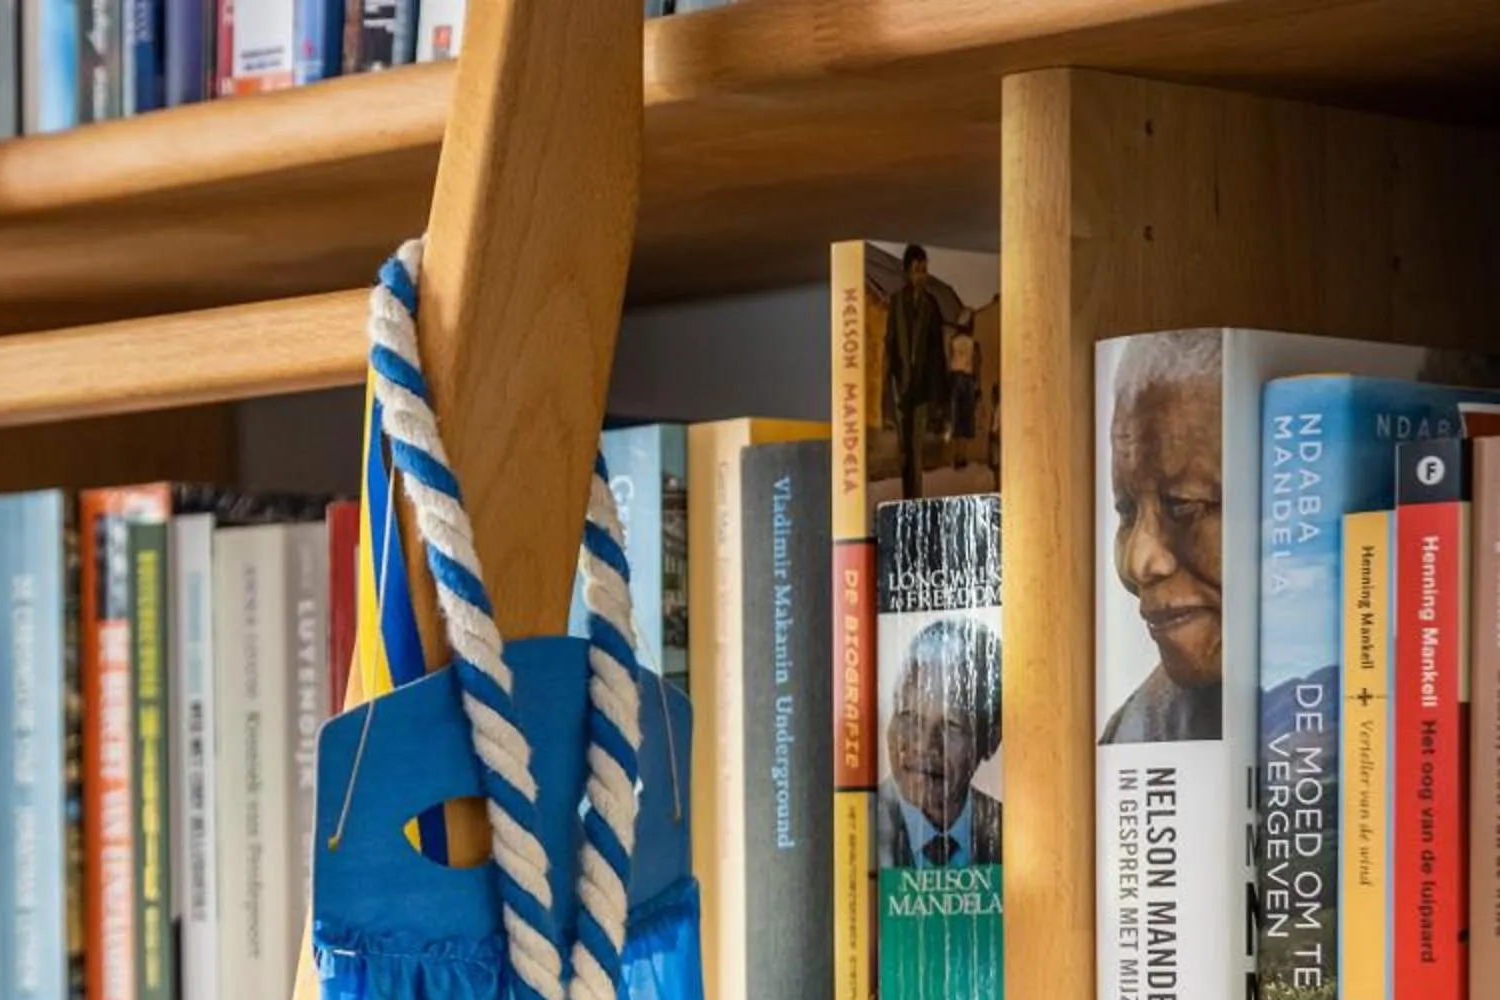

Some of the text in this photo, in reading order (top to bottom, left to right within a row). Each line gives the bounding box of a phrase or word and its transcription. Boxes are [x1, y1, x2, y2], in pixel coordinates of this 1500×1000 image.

[842, 287, 858, 494] NELSON MANDELA
[1272, 415, 1293, 595] MANDELA
[1298, 413, 1322, 543] NDABA
[1357, 545, 1374, 610] Henning
[772, 478, 794, 848] Vladimir Makanin Underground
[842, 569, 860, 770] DE BIOGRAFIE
[1360, 613, 1374, 670] Mankell
[1119, 768, 1138, 791] IN
[1360, 794, 1370, 819] van
[1418, 536, 1439, 965] Henning Mankell Het oog van de luipaard
[899, 866, 994, 894] NELSON
[1119, 799, 1139, 900] GESPREK
[1146, 766, 1178, 889] NELSON
[1266, 732, 1289, 938] VERGEVEN
[1293, 683, 1323, 988] DE MOED OM TE
[1360, 823, 1373, 842] de
[888, 892, 1003, 917] MANDELA
[1119, 906, 1139, 952] MET
